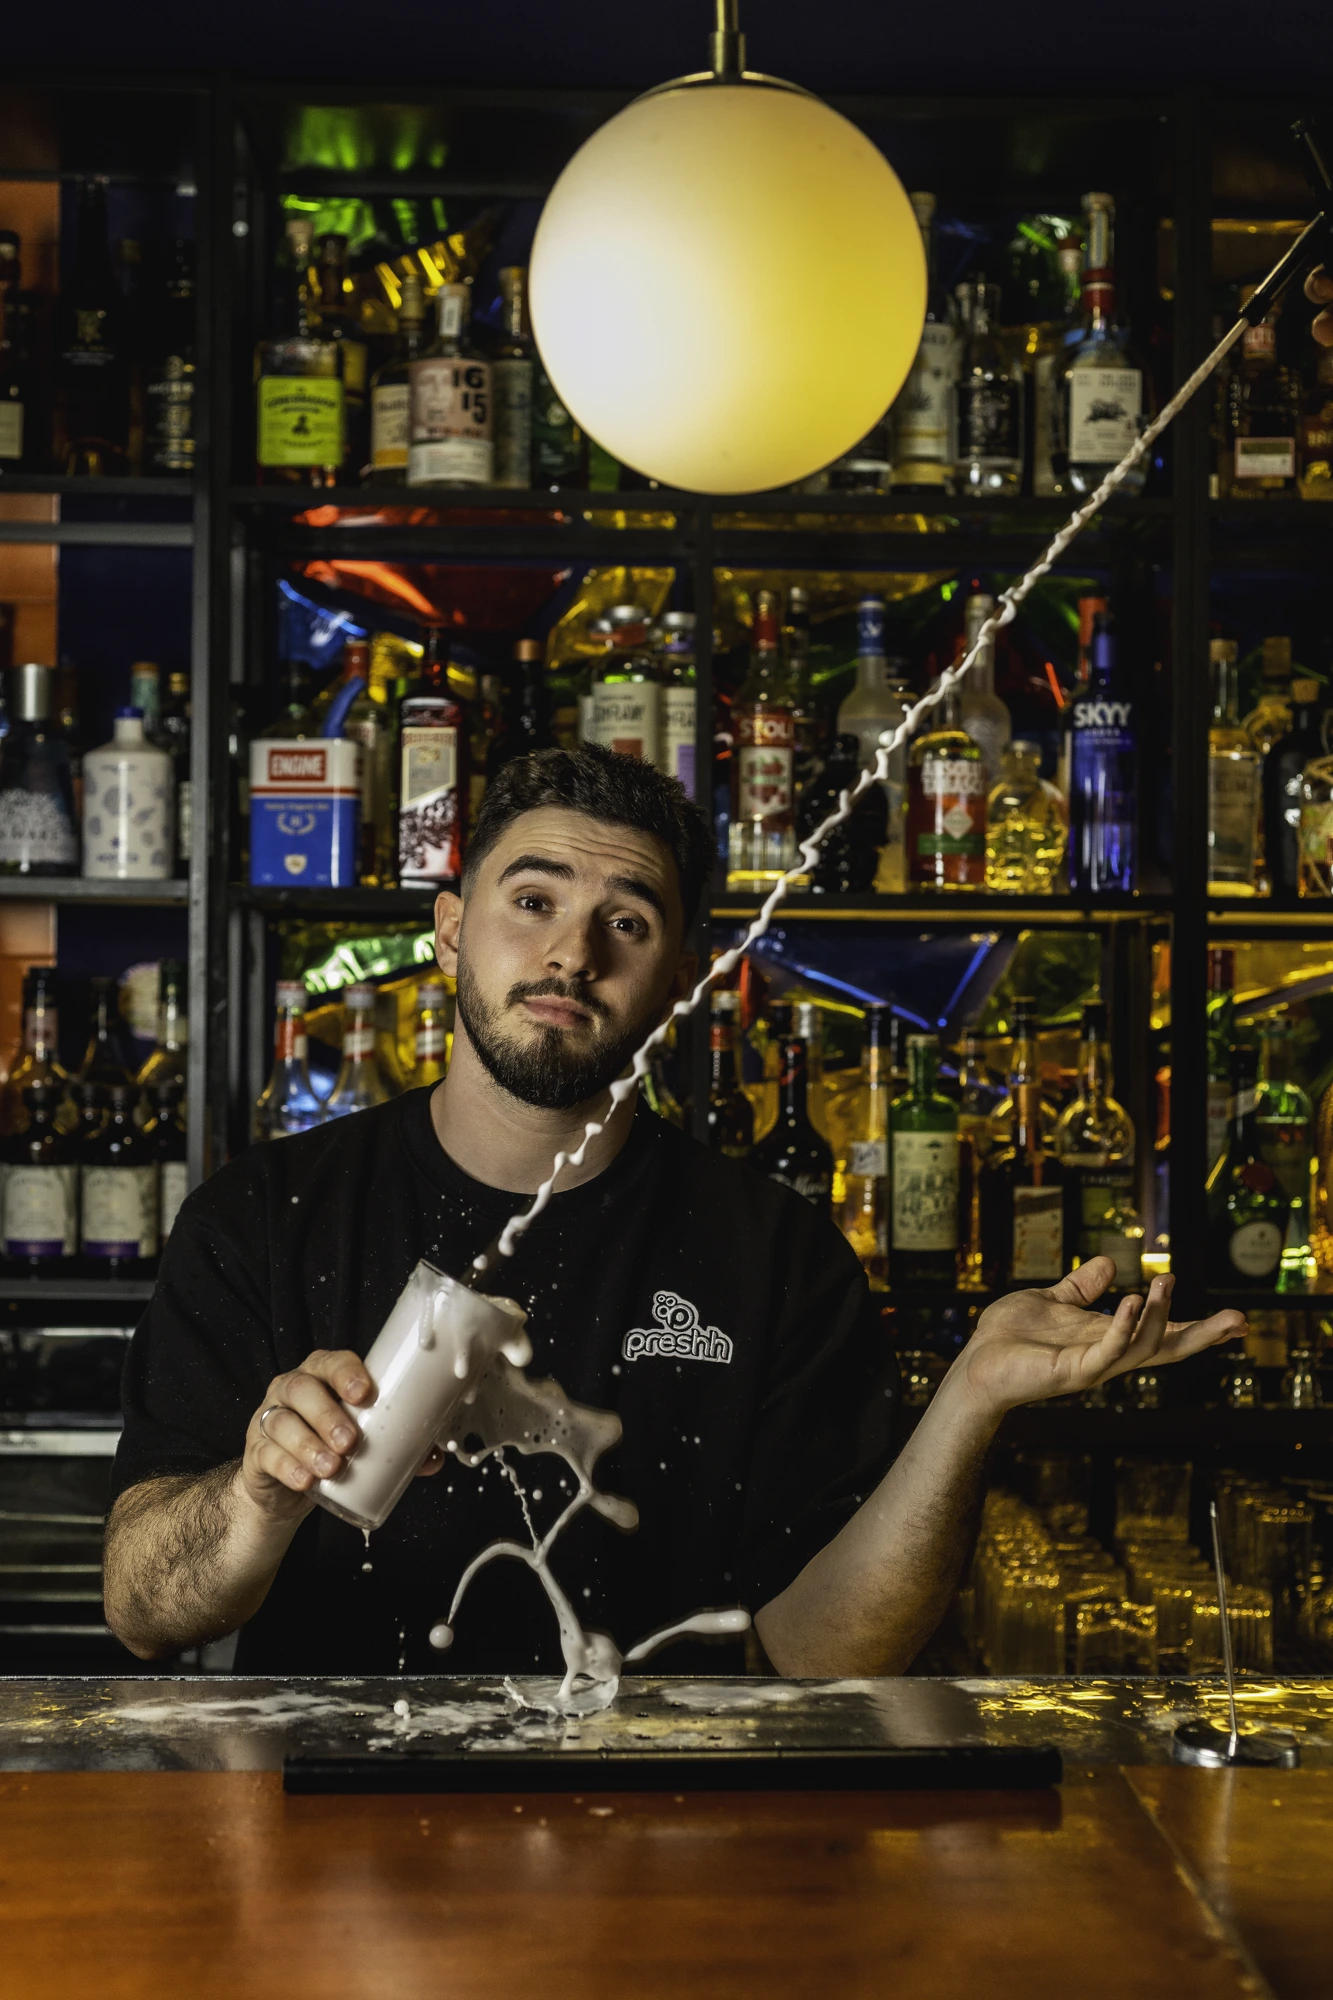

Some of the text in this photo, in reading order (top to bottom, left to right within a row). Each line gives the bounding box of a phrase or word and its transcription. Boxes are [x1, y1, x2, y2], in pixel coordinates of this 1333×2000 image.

[1073, 702, 1132, 728] SKYY
[271, 754, 323, 778] ENGINE
[624, 1328, 730, 1360] preshh
